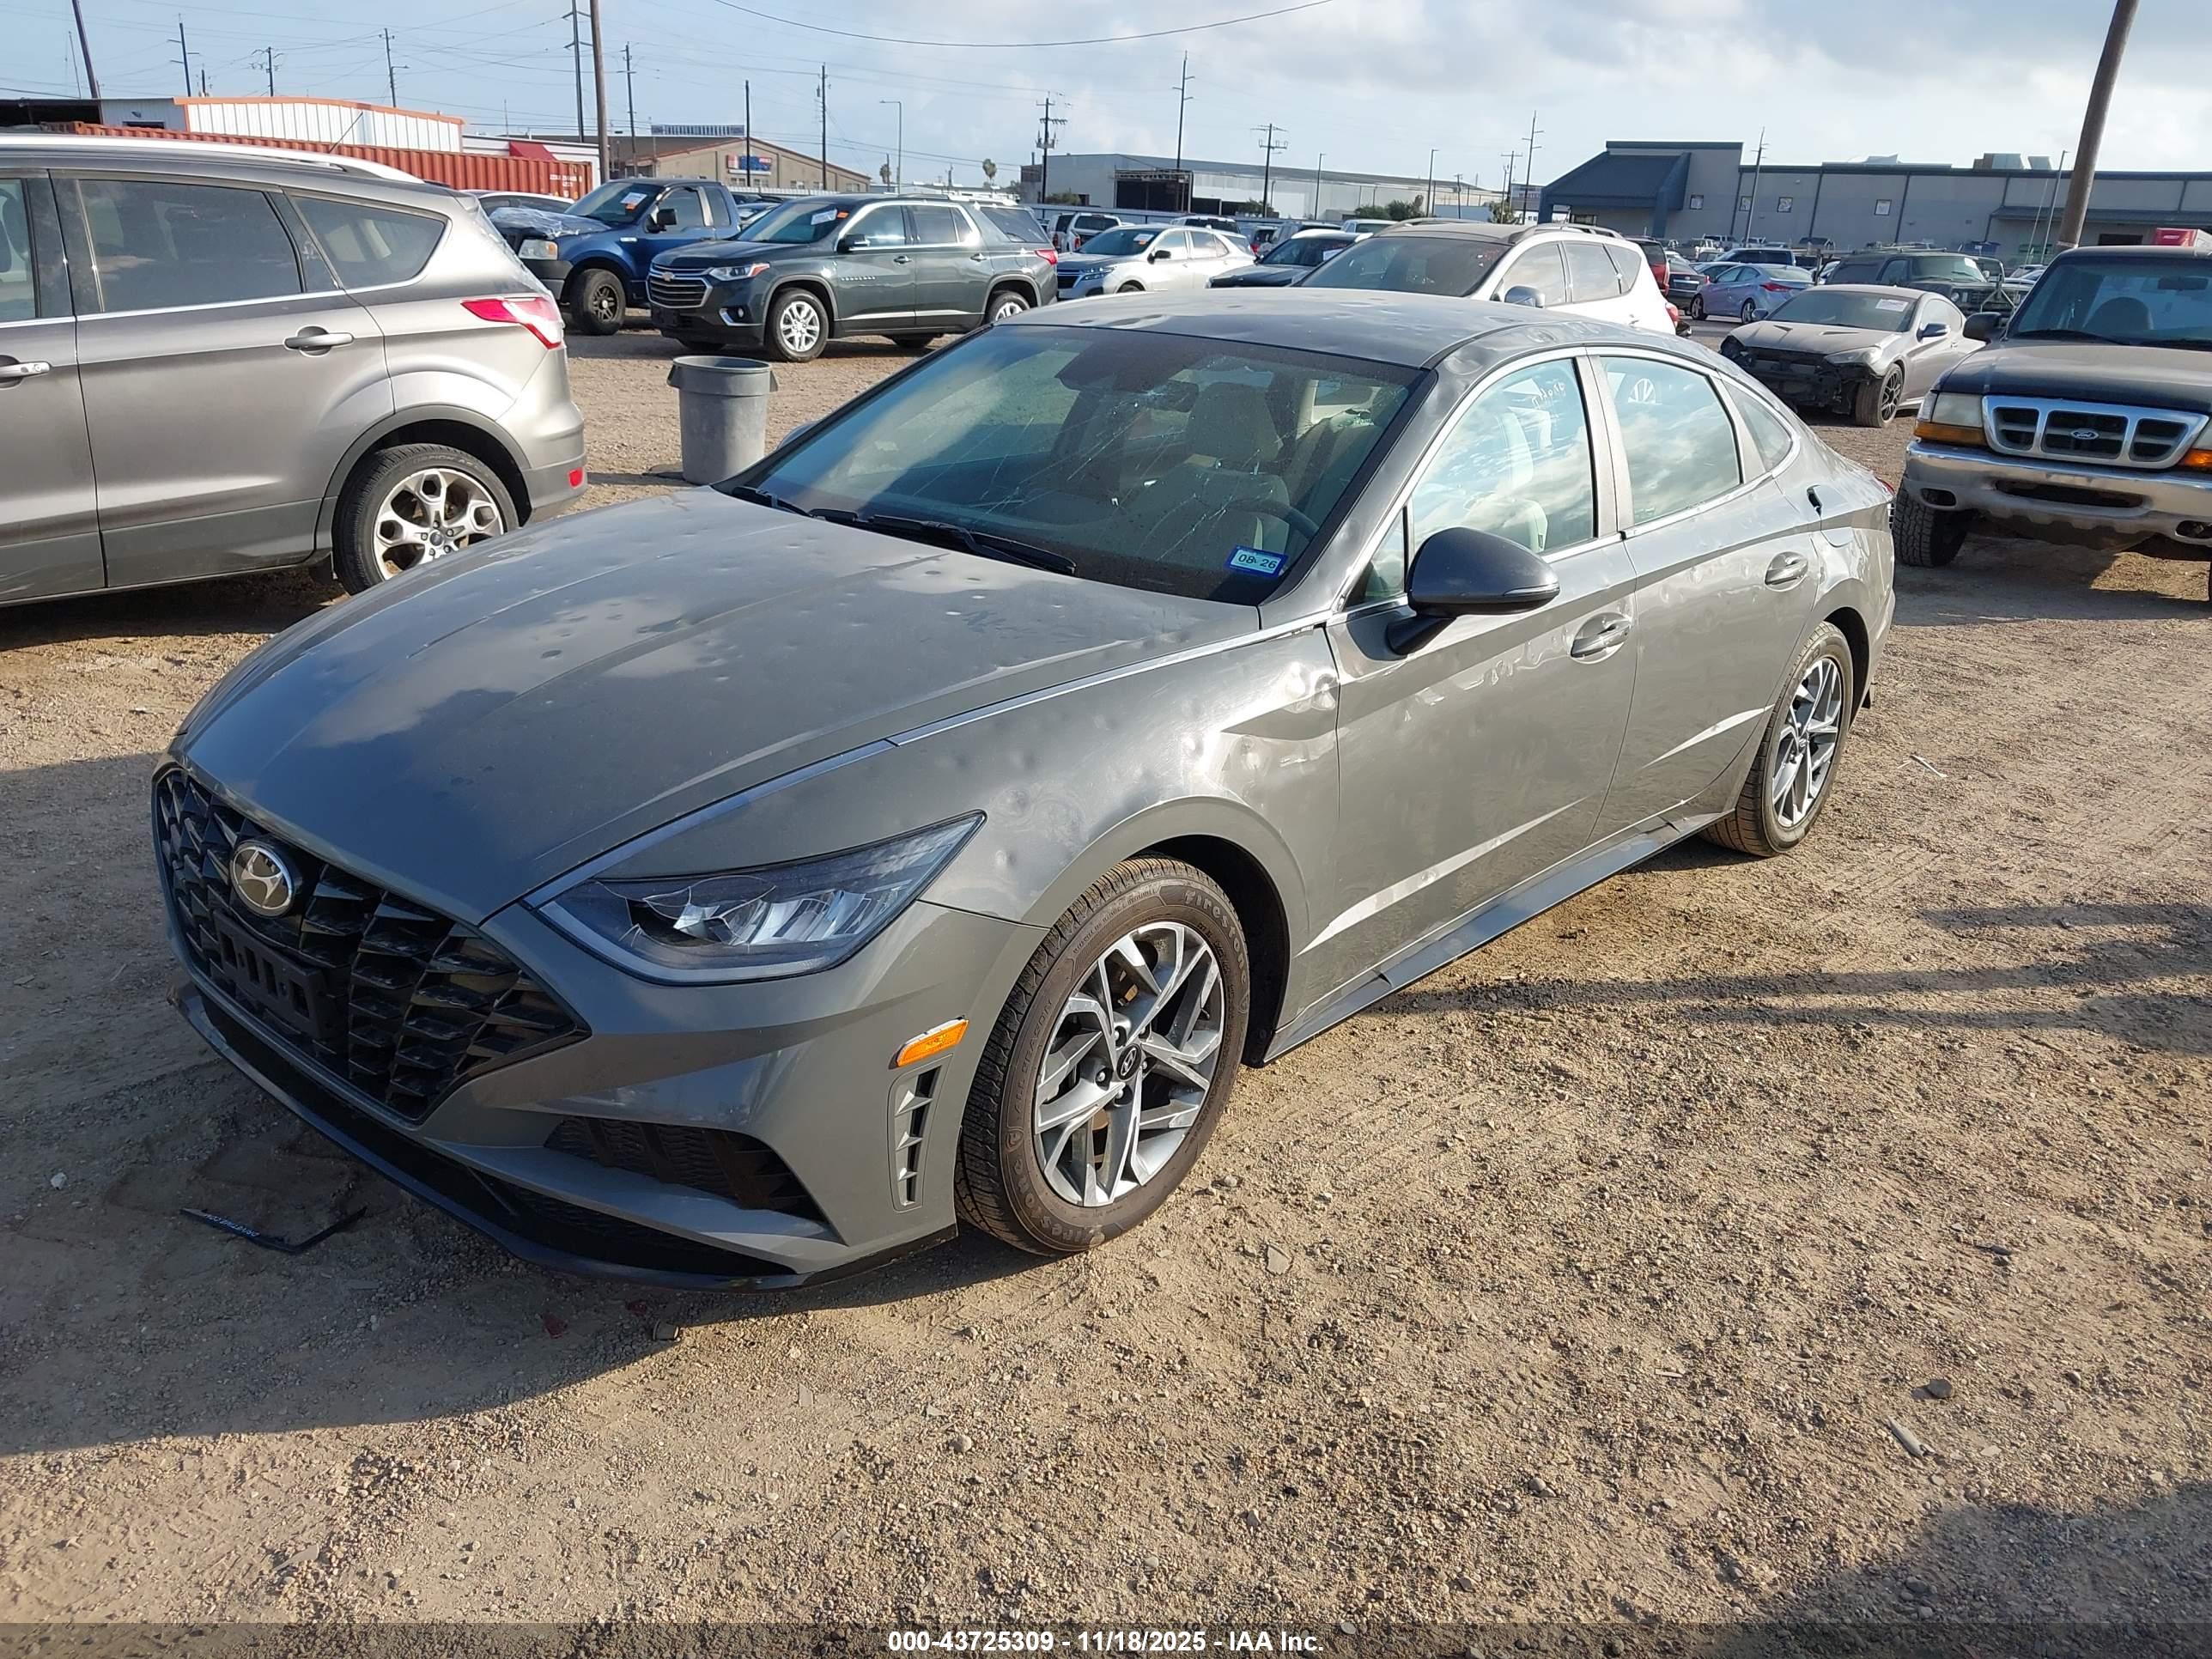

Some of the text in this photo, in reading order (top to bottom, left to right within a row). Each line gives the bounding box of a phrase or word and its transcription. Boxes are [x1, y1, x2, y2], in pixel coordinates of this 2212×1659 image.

[1238, 554, 1278, 569] 08 26
[1183, 890, 1248, 984] Firestone
